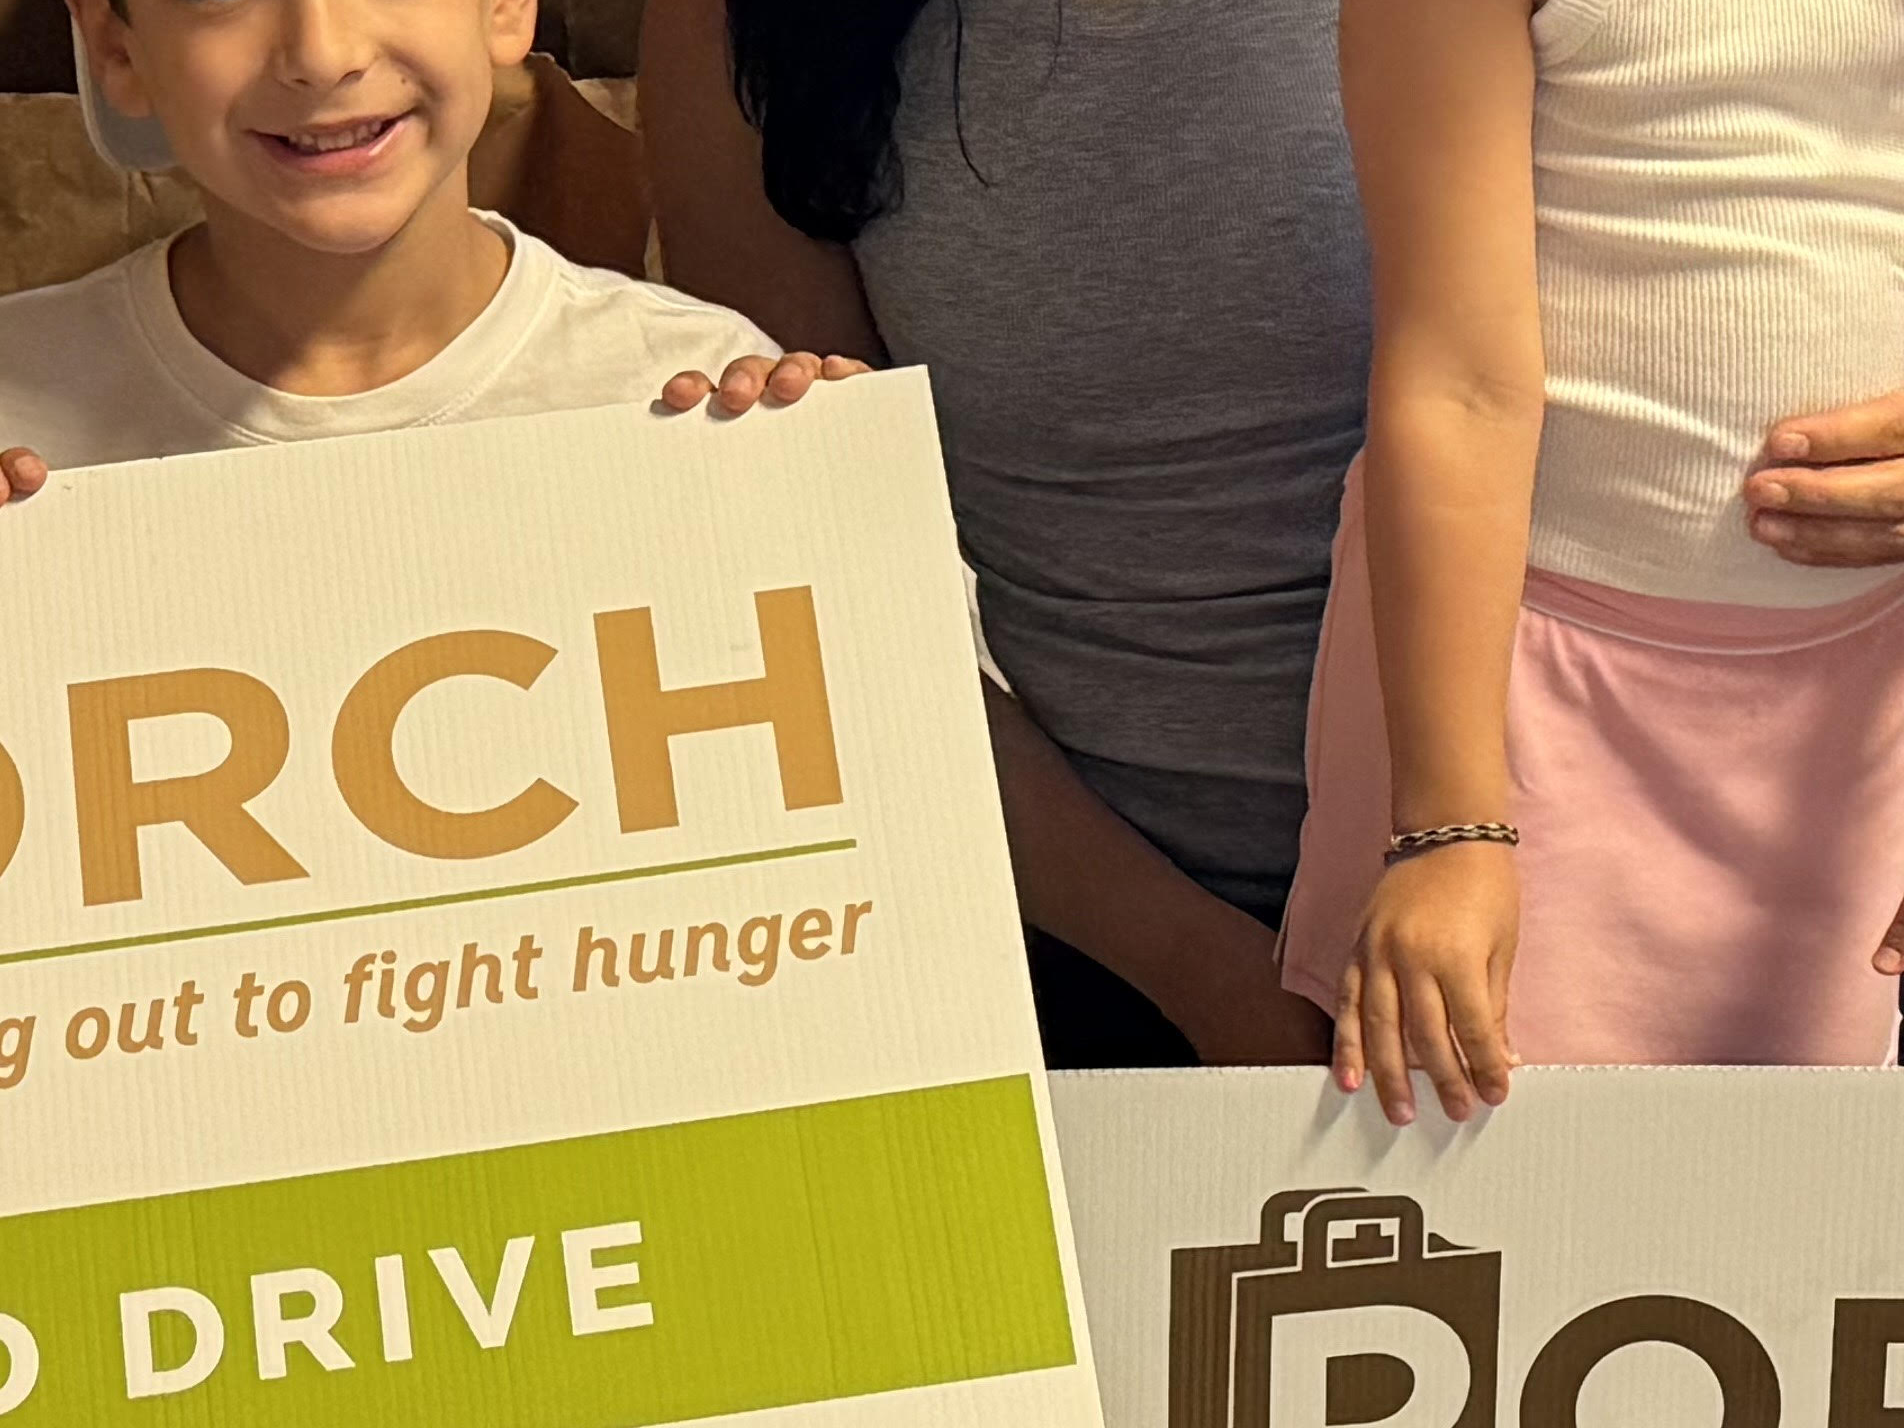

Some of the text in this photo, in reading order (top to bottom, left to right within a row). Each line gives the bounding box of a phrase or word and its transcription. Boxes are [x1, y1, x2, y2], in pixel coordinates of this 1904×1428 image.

[65, 980, 205, 1060] out
[233, 972, 311, 1039] to
[344, 934, 543, 1033] fight
[572, 900, 873, 992] hunger
[119, 1221, 655, 1399] DRIVE
